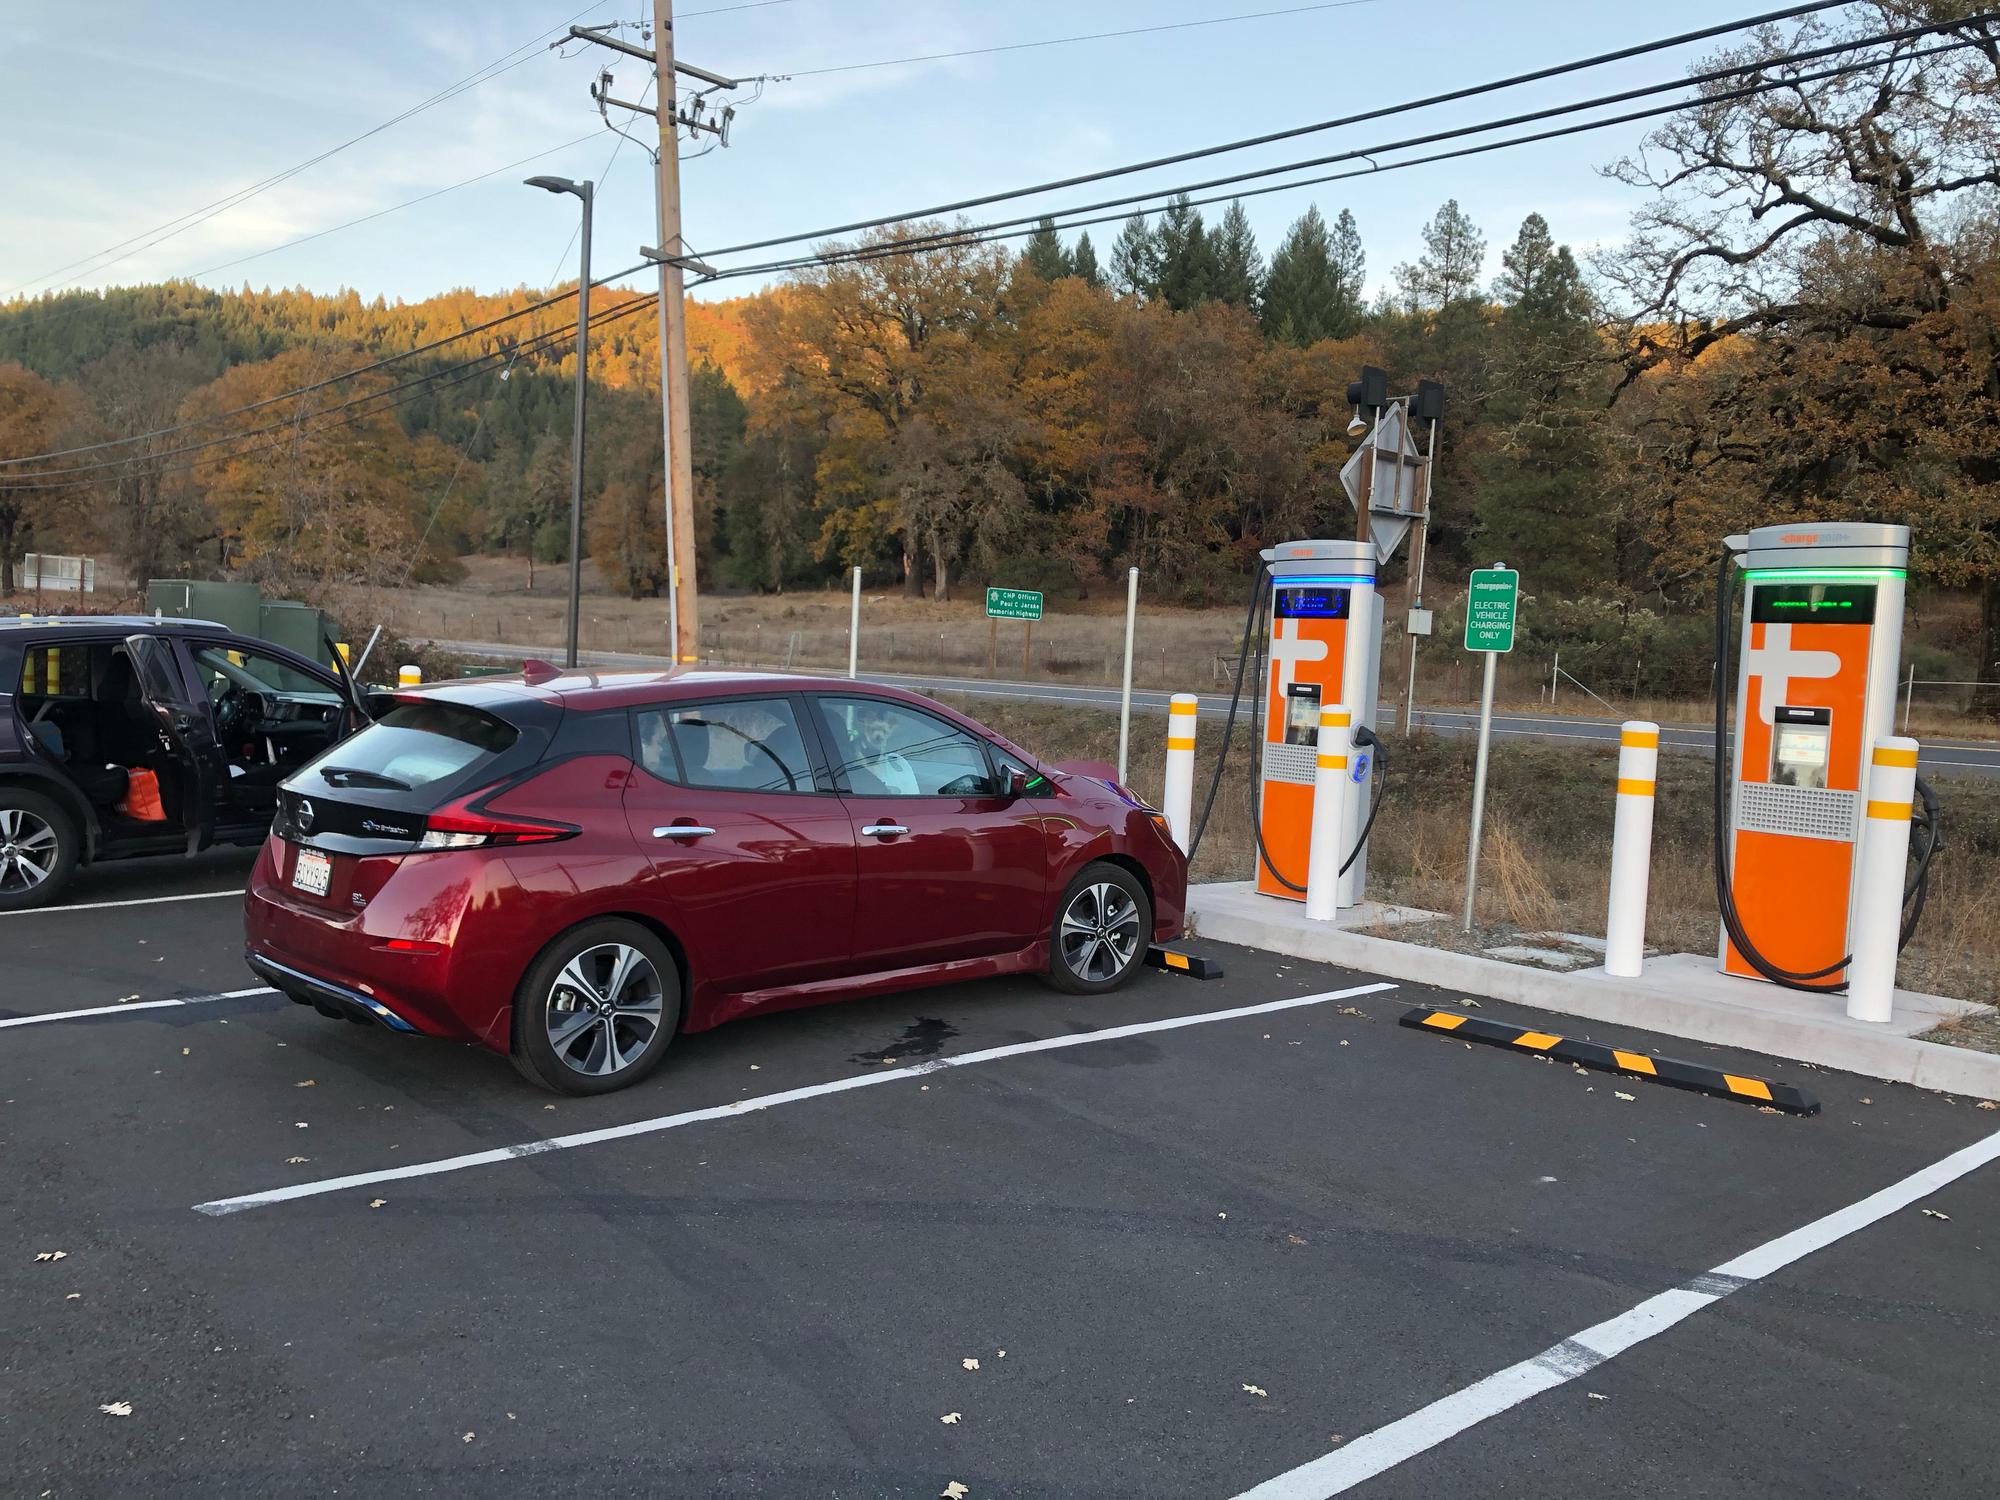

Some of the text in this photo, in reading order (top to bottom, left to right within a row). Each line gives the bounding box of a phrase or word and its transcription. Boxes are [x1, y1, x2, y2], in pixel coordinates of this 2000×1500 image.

[1017, 593, 1038, 601] Officer
[1474, 601, 1510, 610] ELECTRIC
[988, 608, 1039, 618] Memorial Highway
[1476, 611, 1507, 619] VEHICLE
[1470, 621, 1511, 630] CHARGING
[1479, 631, 1500, 639] ONLY
